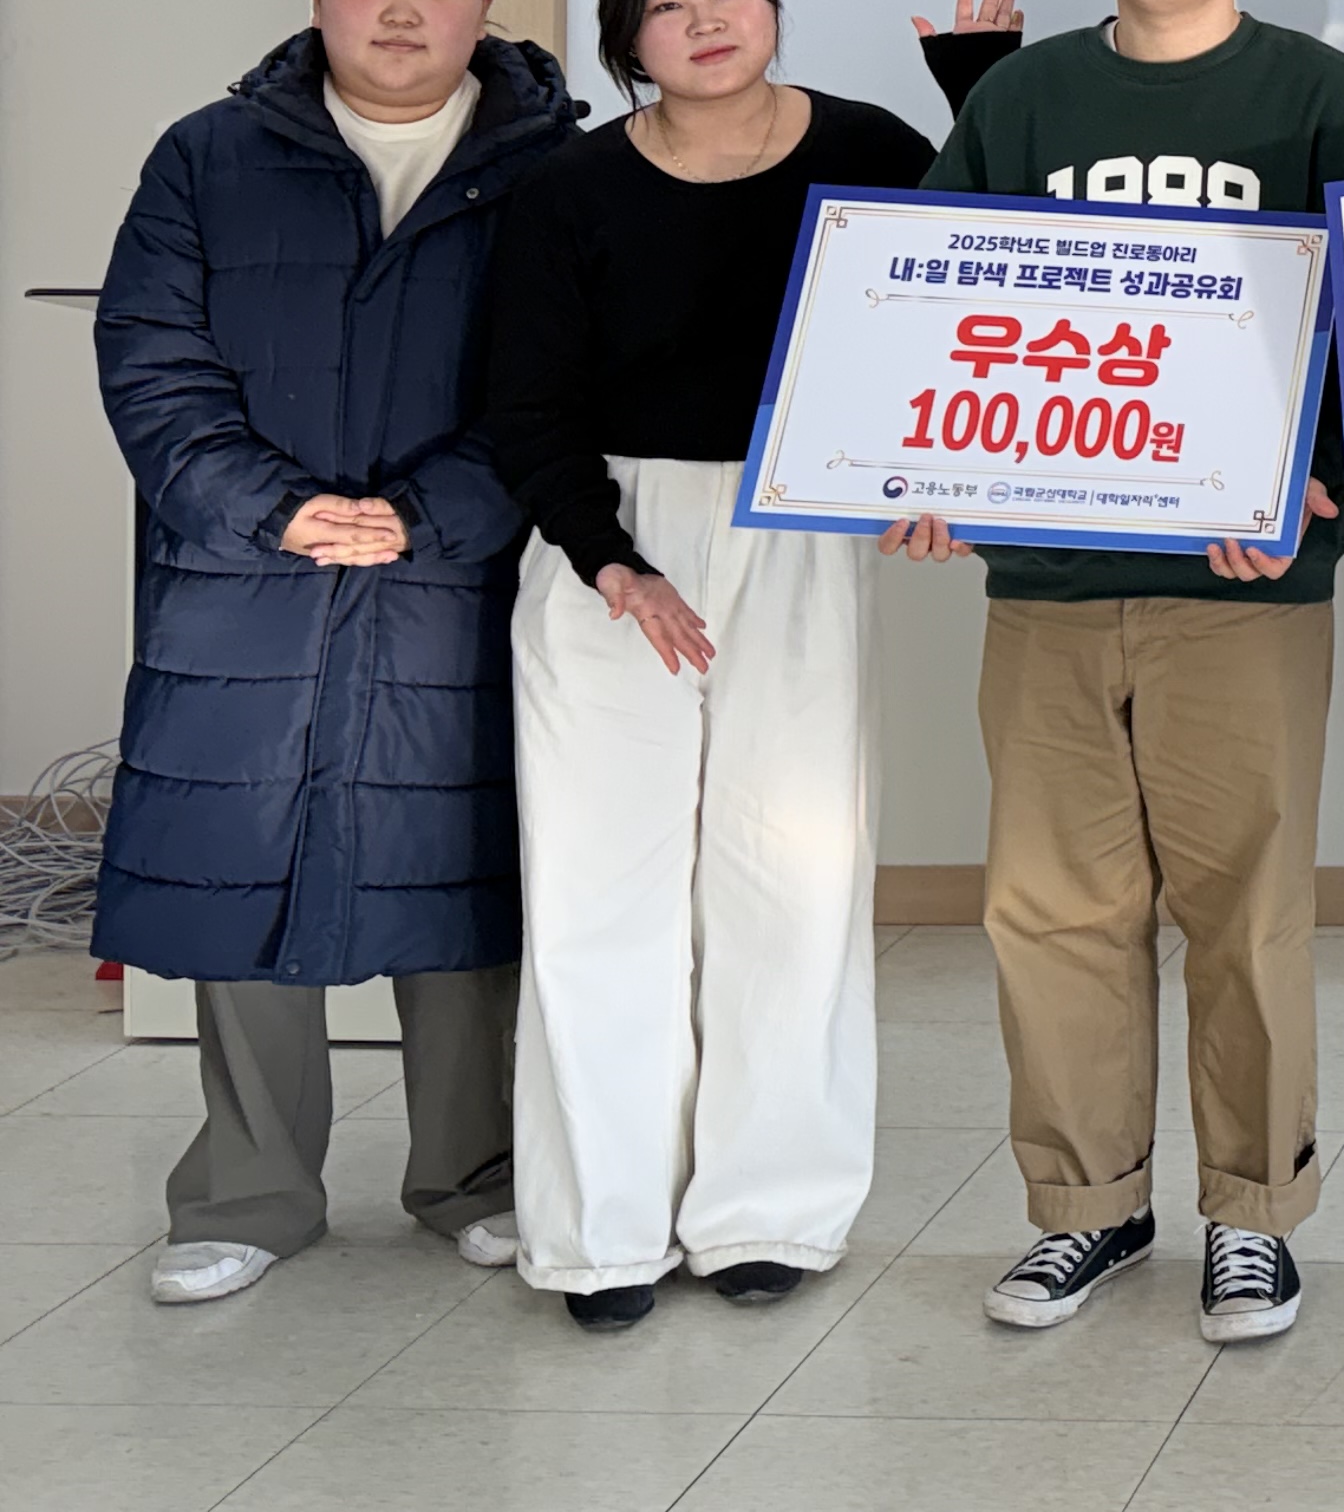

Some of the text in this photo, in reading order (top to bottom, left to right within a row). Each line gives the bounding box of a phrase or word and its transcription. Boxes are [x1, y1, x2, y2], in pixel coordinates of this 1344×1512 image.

[948, 234, 1197, 264] 2025학년도 빌드업 진로동아리
[890, 256, 1243, 302] 내:일 탐색 프로젝트 성과공유회
[949, 314, 1171, 387] 우수상
[902, 389, 1185, 463] 100,000원
[912, 481, 977, 497] 고용노동부
